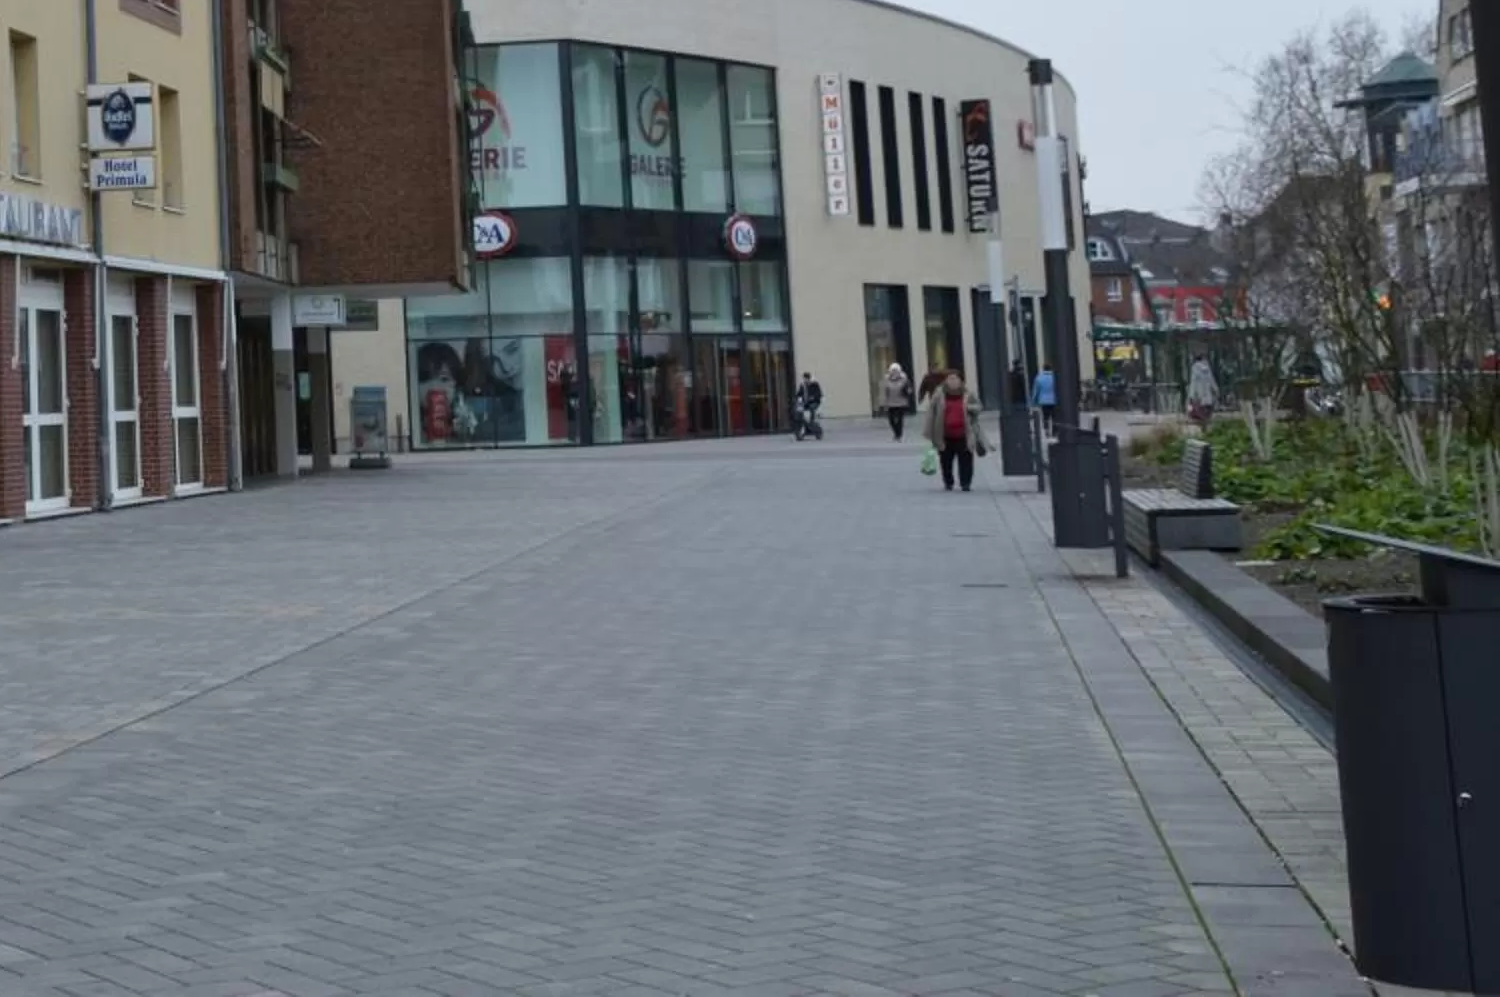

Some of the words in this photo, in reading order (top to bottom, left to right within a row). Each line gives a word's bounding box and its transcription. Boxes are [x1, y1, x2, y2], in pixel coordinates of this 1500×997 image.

[104, 159, 137, 172] Hotel
[470, 146, 527, 171] ERIE
[629, 154, 687, 178] GALERE
[97, 173, 147, 187] Primula
